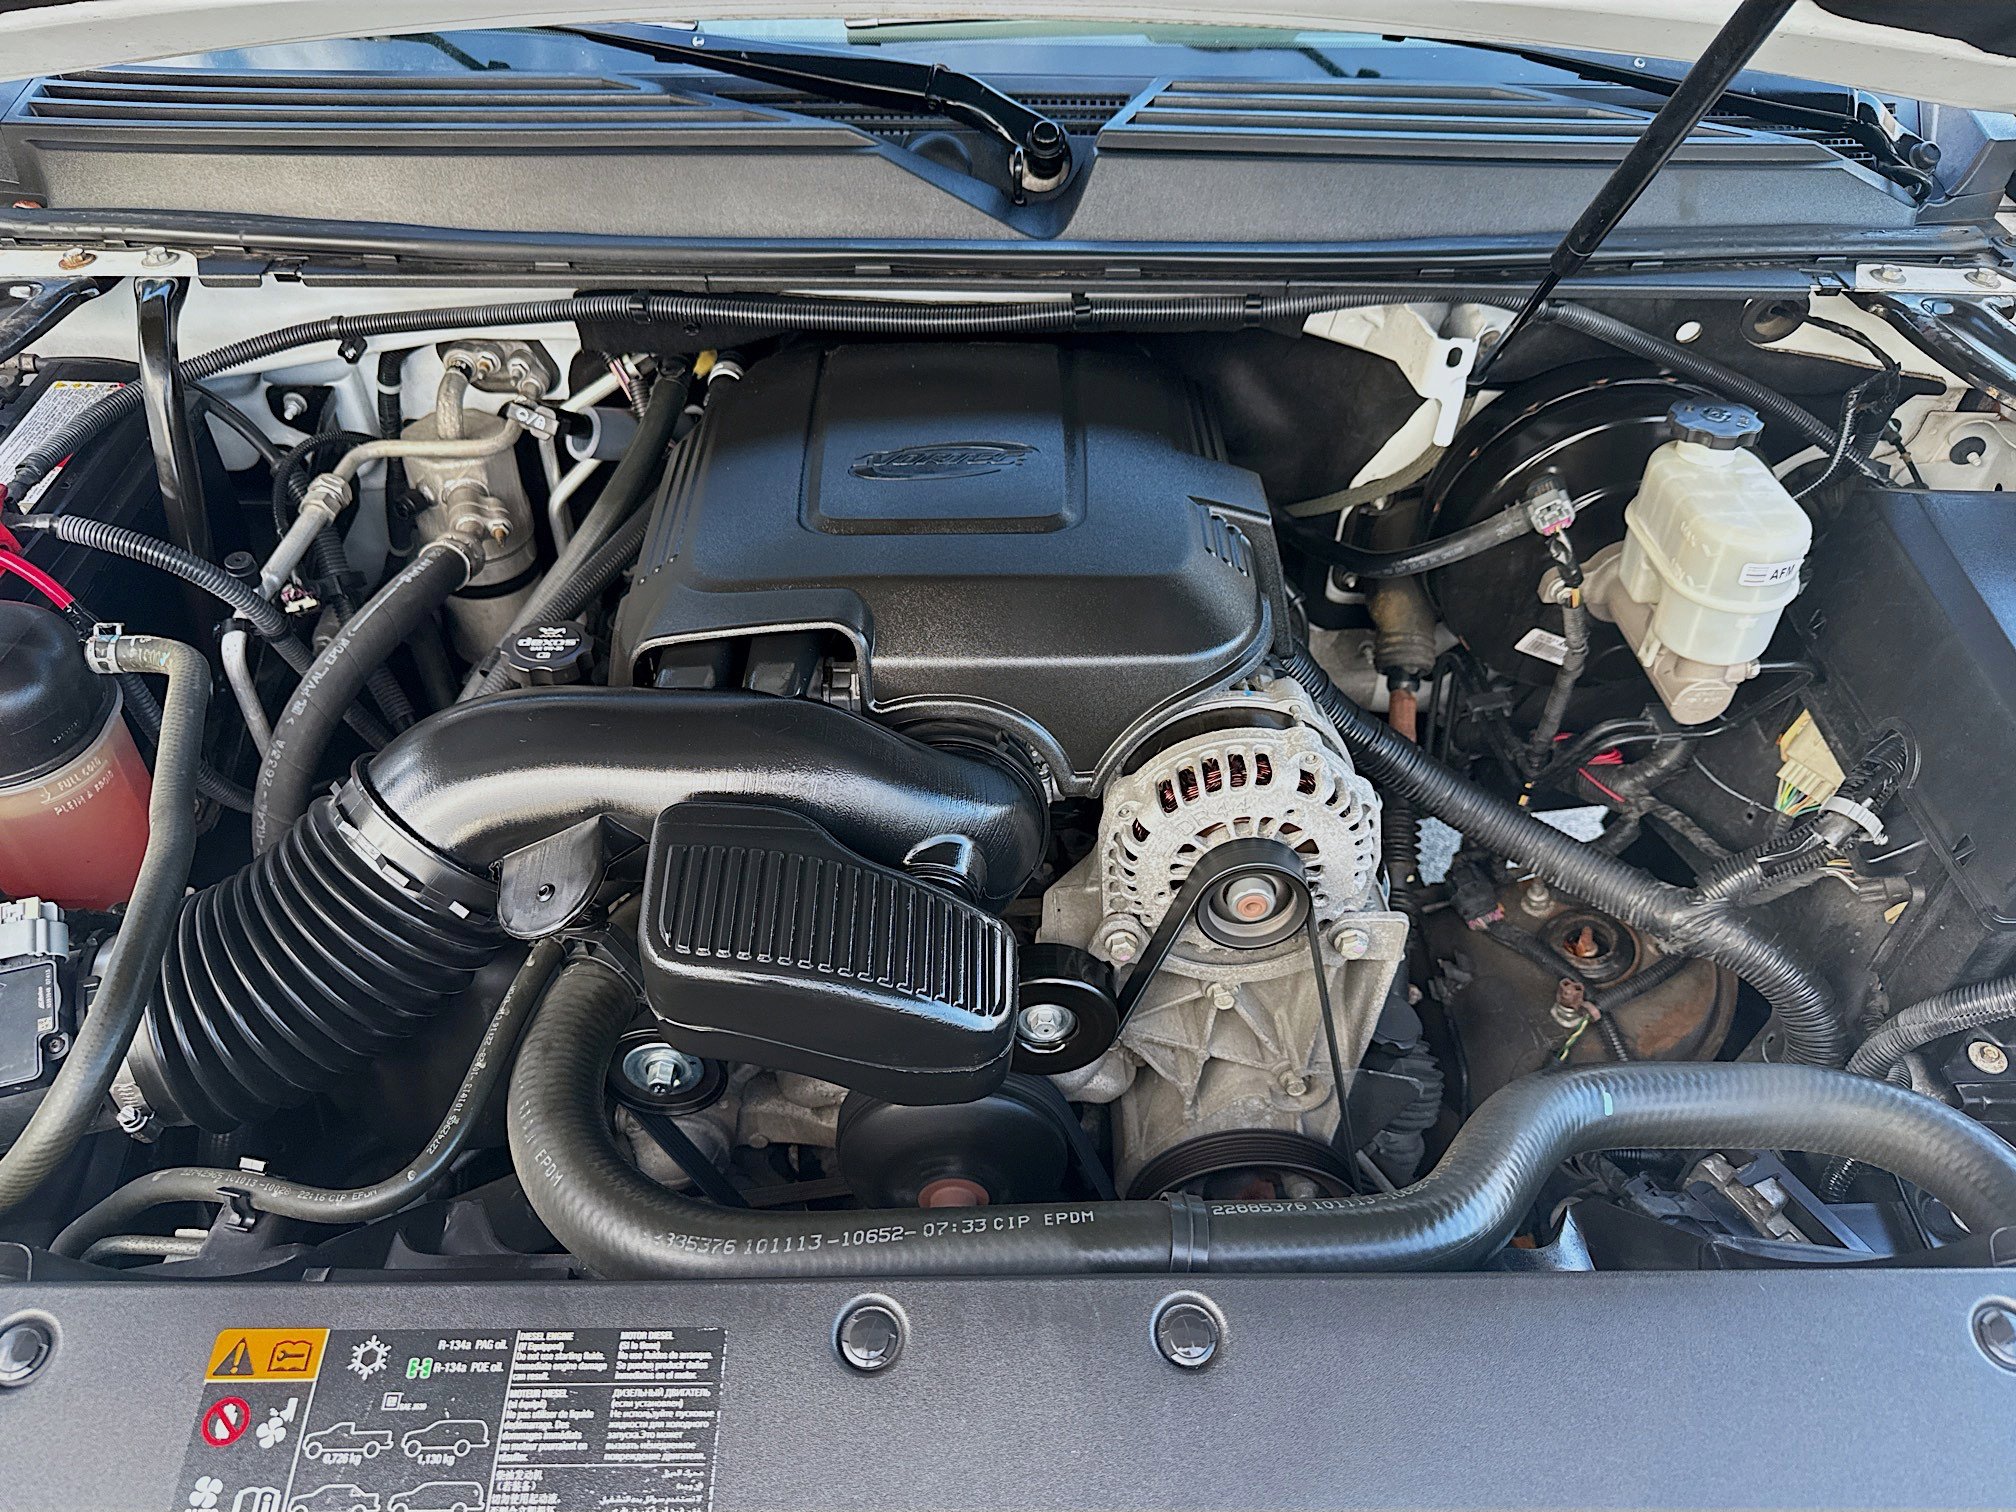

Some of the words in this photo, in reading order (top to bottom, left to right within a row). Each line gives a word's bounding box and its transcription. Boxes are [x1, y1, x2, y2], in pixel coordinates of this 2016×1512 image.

[57, 773, 82, 791] FULL
[535, 1149, 564, 1187] EPDM
[1044, 1210, 1095, 1227] EPDM
